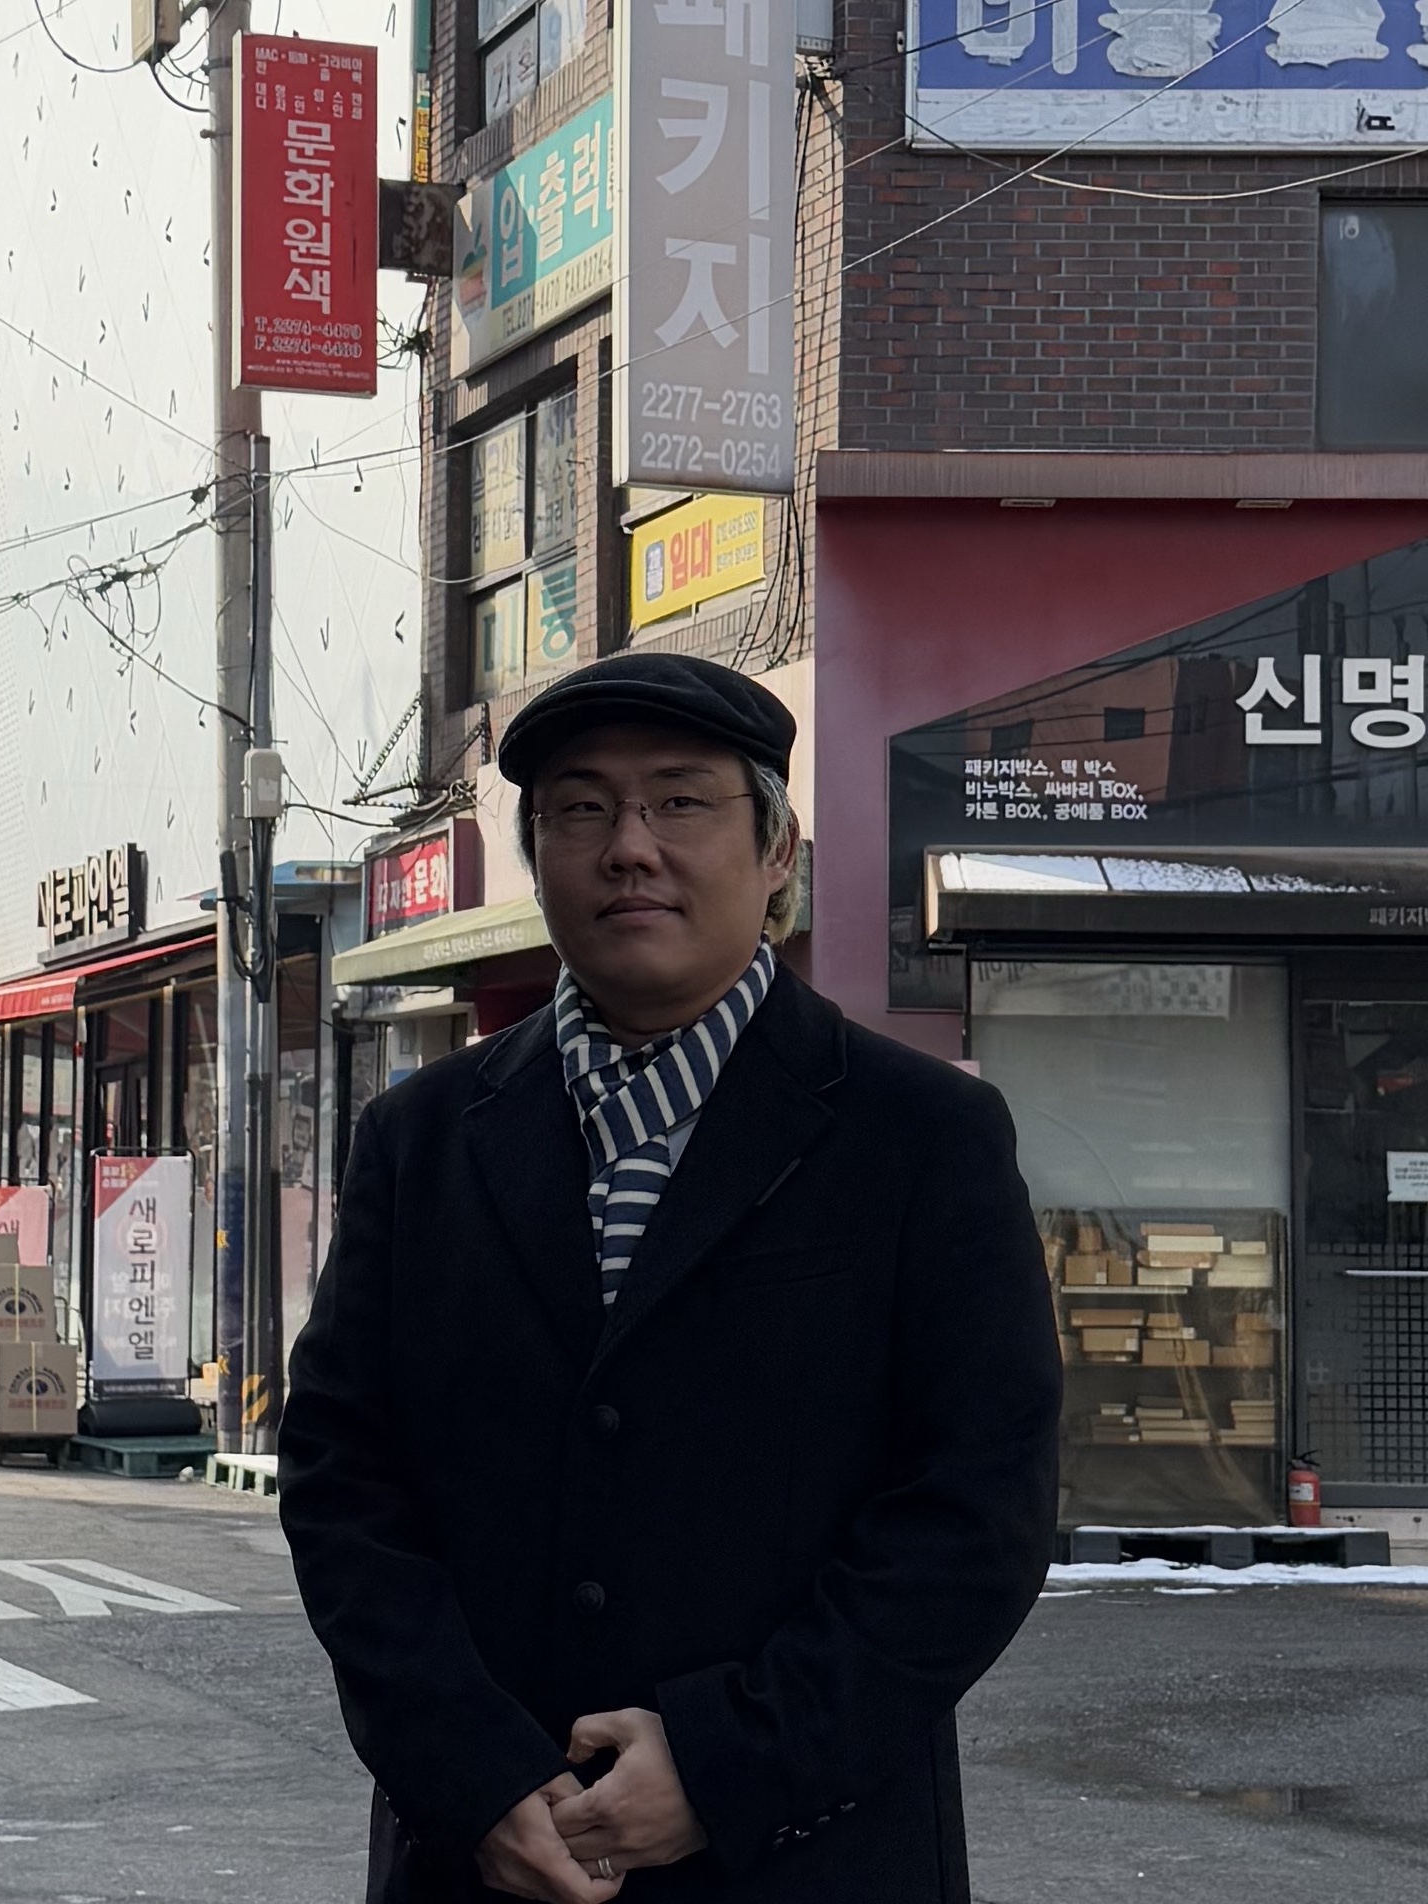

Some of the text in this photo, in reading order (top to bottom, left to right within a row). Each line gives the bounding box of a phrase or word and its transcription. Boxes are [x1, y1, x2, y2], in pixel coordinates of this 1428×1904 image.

[283, 118, 336, 315] 문화원색
[640, 379, 783, 430] 2277-2763
[640, 430, 781, 480] 2272-0254
[670, 517, 712, 591] 임대
[1110, 804, 1148, 820] BOX
[128, 1196, 157, 1361] 새로피엔엘
